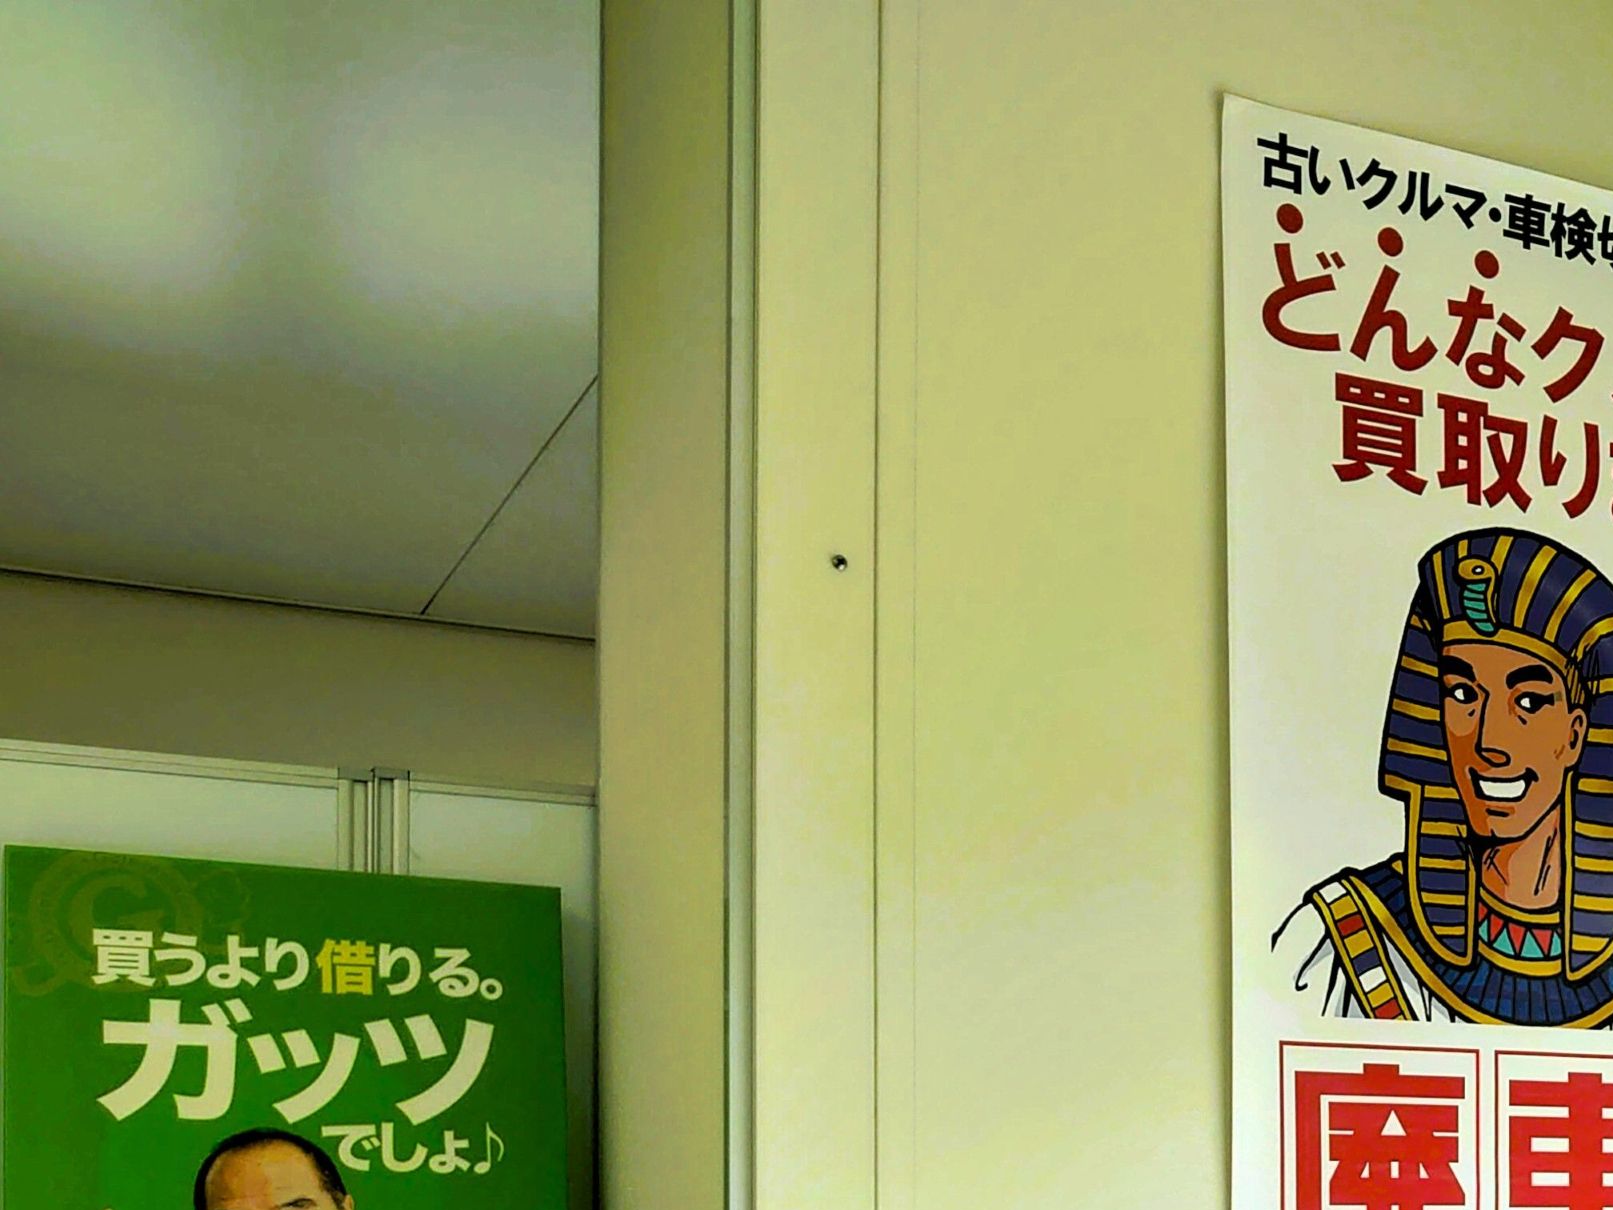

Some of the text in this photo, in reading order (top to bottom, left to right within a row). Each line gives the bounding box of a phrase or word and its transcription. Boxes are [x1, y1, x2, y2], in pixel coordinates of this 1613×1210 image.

[92, 928, 503, 1001] 買うより借りる。
[98, 999, 494, 1125] ガッツ
